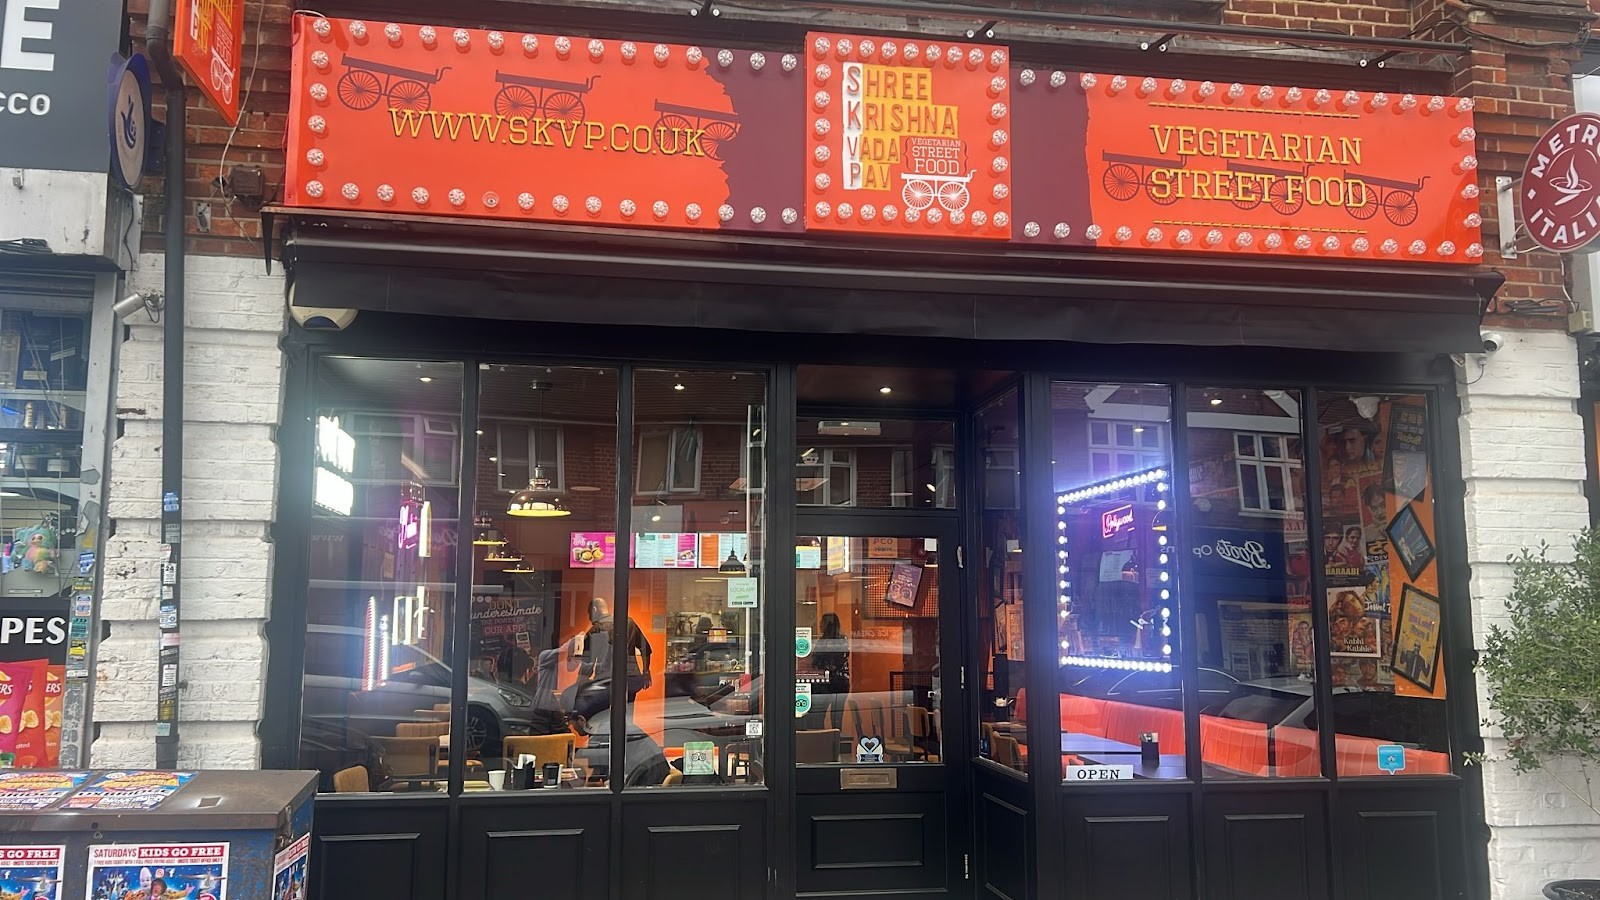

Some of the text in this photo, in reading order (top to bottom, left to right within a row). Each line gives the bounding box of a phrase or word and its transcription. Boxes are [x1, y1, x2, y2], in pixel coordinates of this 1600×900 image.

[847, 65, 929, 101] SHREE
[847, 100, 956, 136] KRISHNA
[388, 107, 706, 157] WWW.SKVP.CO.UK
[911, 137, 961, 147] VEGETARIAN
[1149, 124, 1363, 165] VEGETARIAN
[847, 136, 899, 162] VADA
[911, 146, 961, 159] STREET
[1530, 123, 1600, 179] METR
[849, 162, 891, 189] PAV
[914, 158, 960, 175] FOOD
[1151, 167, 1368, 208] STREET FOOD
[1530, 197, 1600, 244] ITALI
[1077, 769, 1120, 780] OPEN
[7, 850, 24, 859] GO
[27, 849, 58, 858] FREE
[93, 846, 222, 859] SATURDAYS KIDS GO FREE
